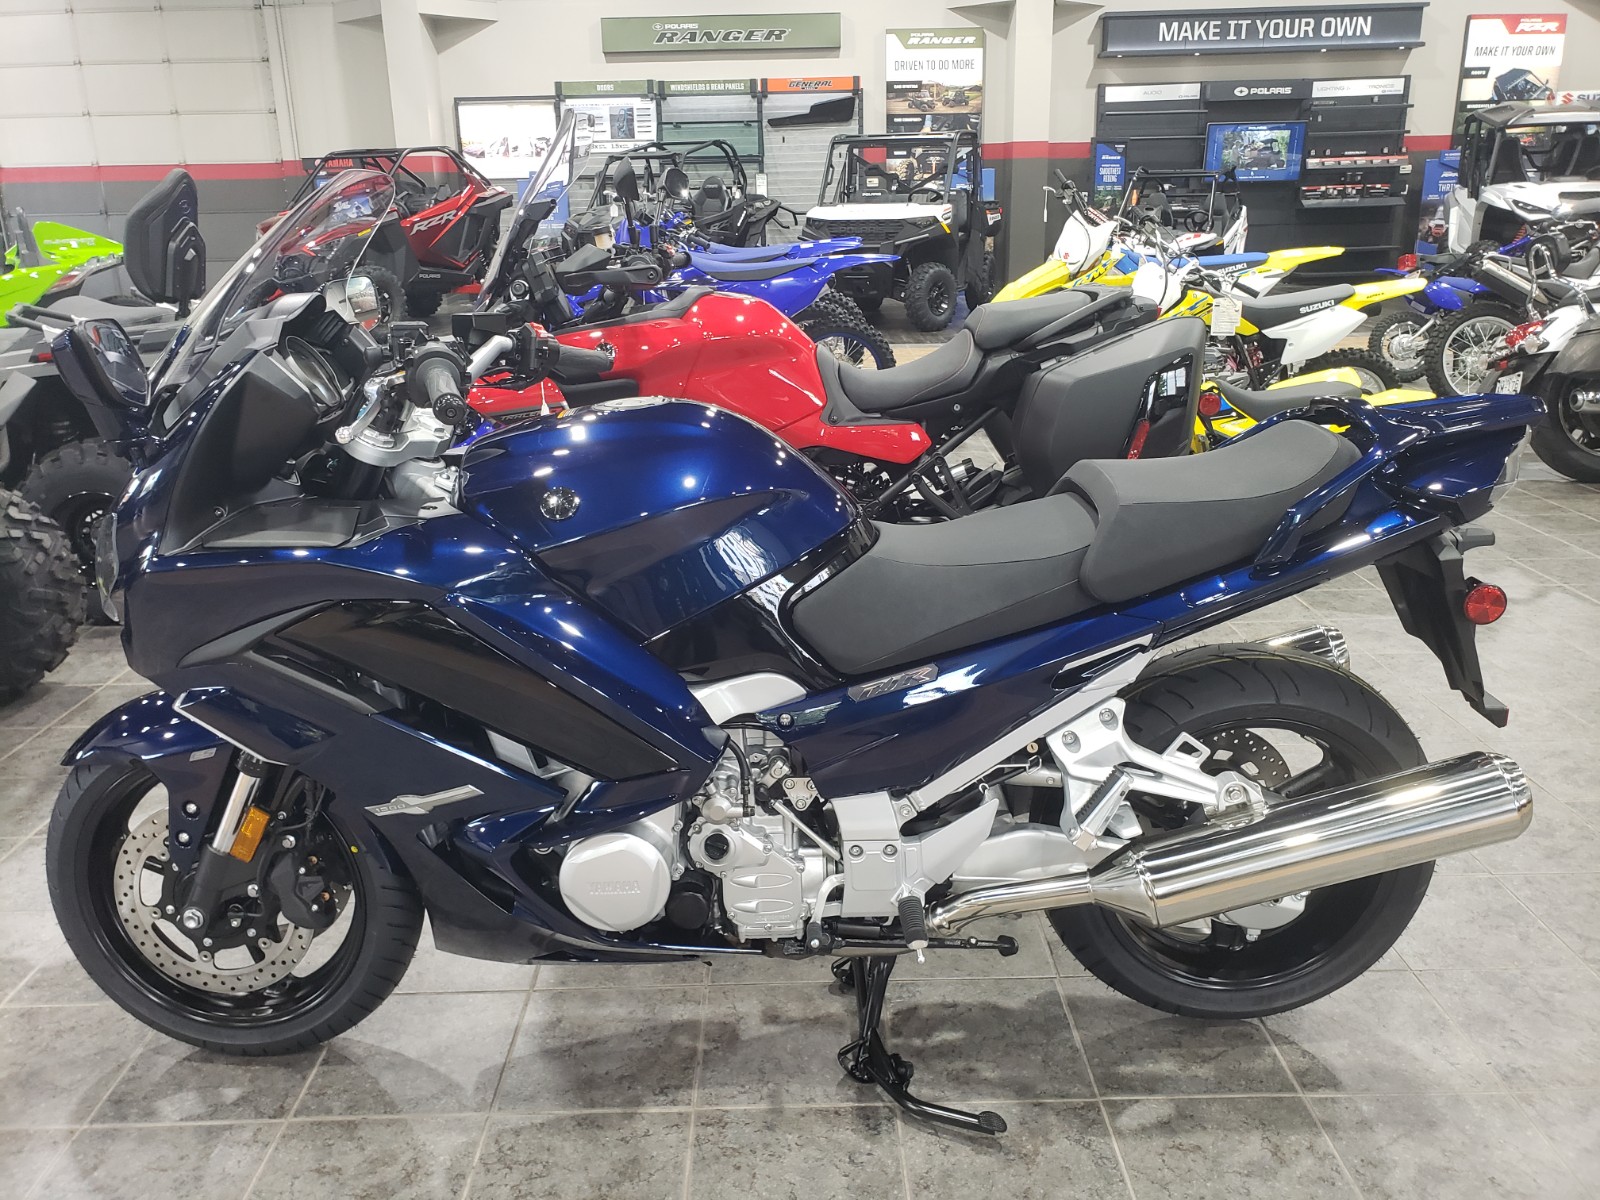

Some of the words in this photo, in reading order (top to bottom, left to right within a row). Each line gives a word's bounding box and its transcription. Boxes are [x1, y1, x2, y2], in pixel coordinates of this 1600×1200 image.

[1158, 21, 1221, 42] MAKE
[1226, 20, 1251, 40] IT
[1256, 17, 1314, 39] YOUR
[1321, 16, 1372, 37] OWN
[653, 28, 789, 45] RANGER
[907, 36, 976, 45] RANGER
[1474, 46, 1499, 57] MAKE
[1500, 46, 1509, 57] IT
[1512, 45, 1534, 56] YOUR
[1535, 45, 1556, 56] OWN
[894, 60, 924, 71] DRIVEN
[926, 60, 936, 70] TO
[938, 59, 949, 70] DO
[951, 58, 975, 70] MORE
[596, 84, 614, 92] DOORS
[670, 84, 705, 92] WINDSHIELDS
[710, 84, 724, 92] REAR
[724, 83, 745, 91] PANELS
[788, 80, 833, 88] GENERAL
[1250, 86, 1292, 95] POLARIS
[410, 210, 457, 236] RZR
[1216, 262, 1248, 274] SUZUKI
[1299, 299, 1335, 314] SUZUKI
[375, 803, 406, 814] 1300
[588, 880, 641, 895] YAMAHA
